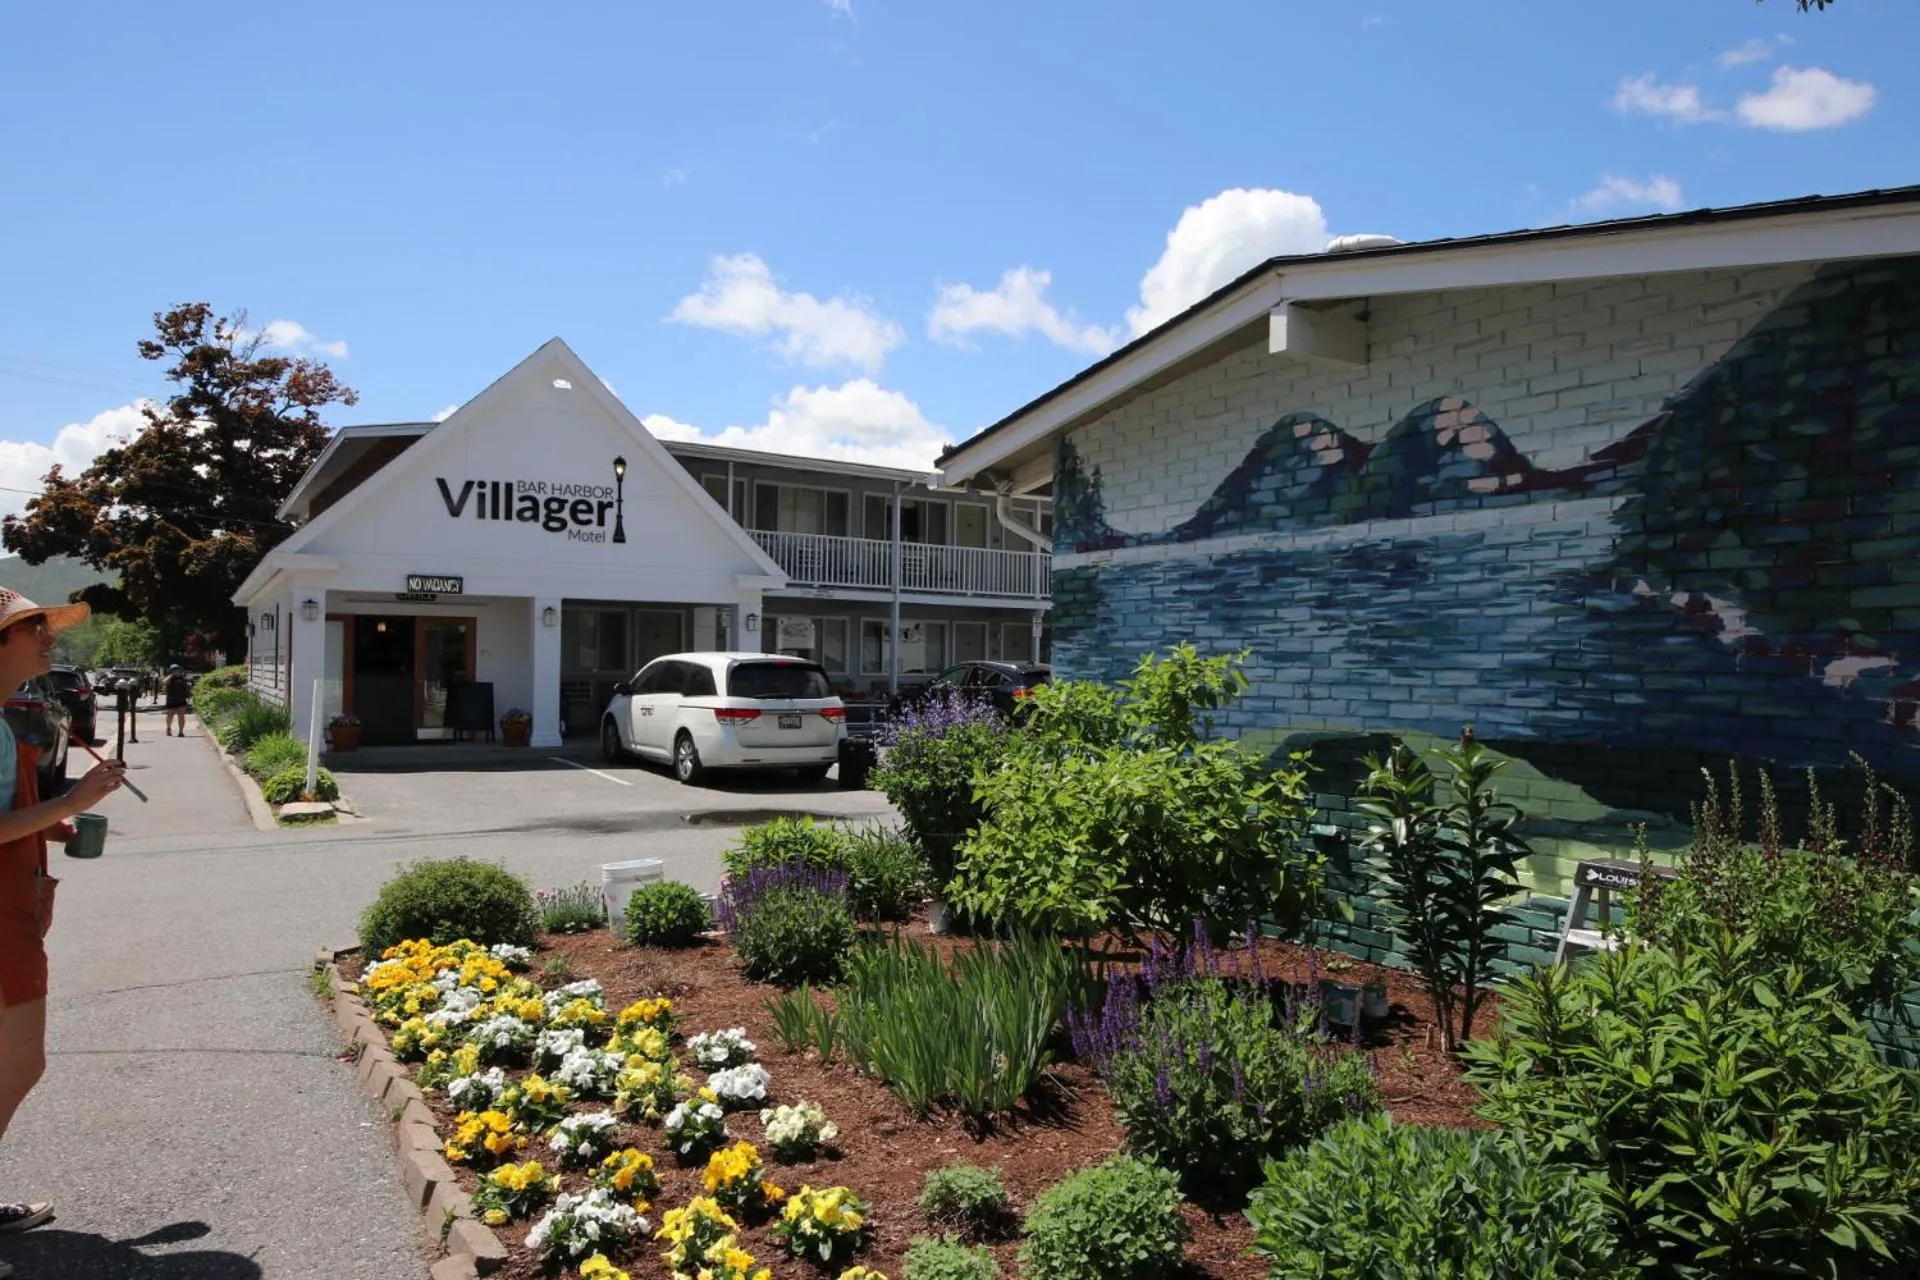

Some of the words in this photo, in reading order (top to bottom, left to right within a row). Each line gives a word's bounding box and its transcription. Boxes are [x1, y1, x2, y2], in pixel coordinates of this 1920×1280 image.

[517, 480, 547, 495] BAR
[551, 483, 614, 499] HARBOR
[435, 477, 614, 533] Villager
[567, 528, 606, 544] Motel
[409, 576, 422, 590] NO
[422, 577, 461, 593] VACANCY
